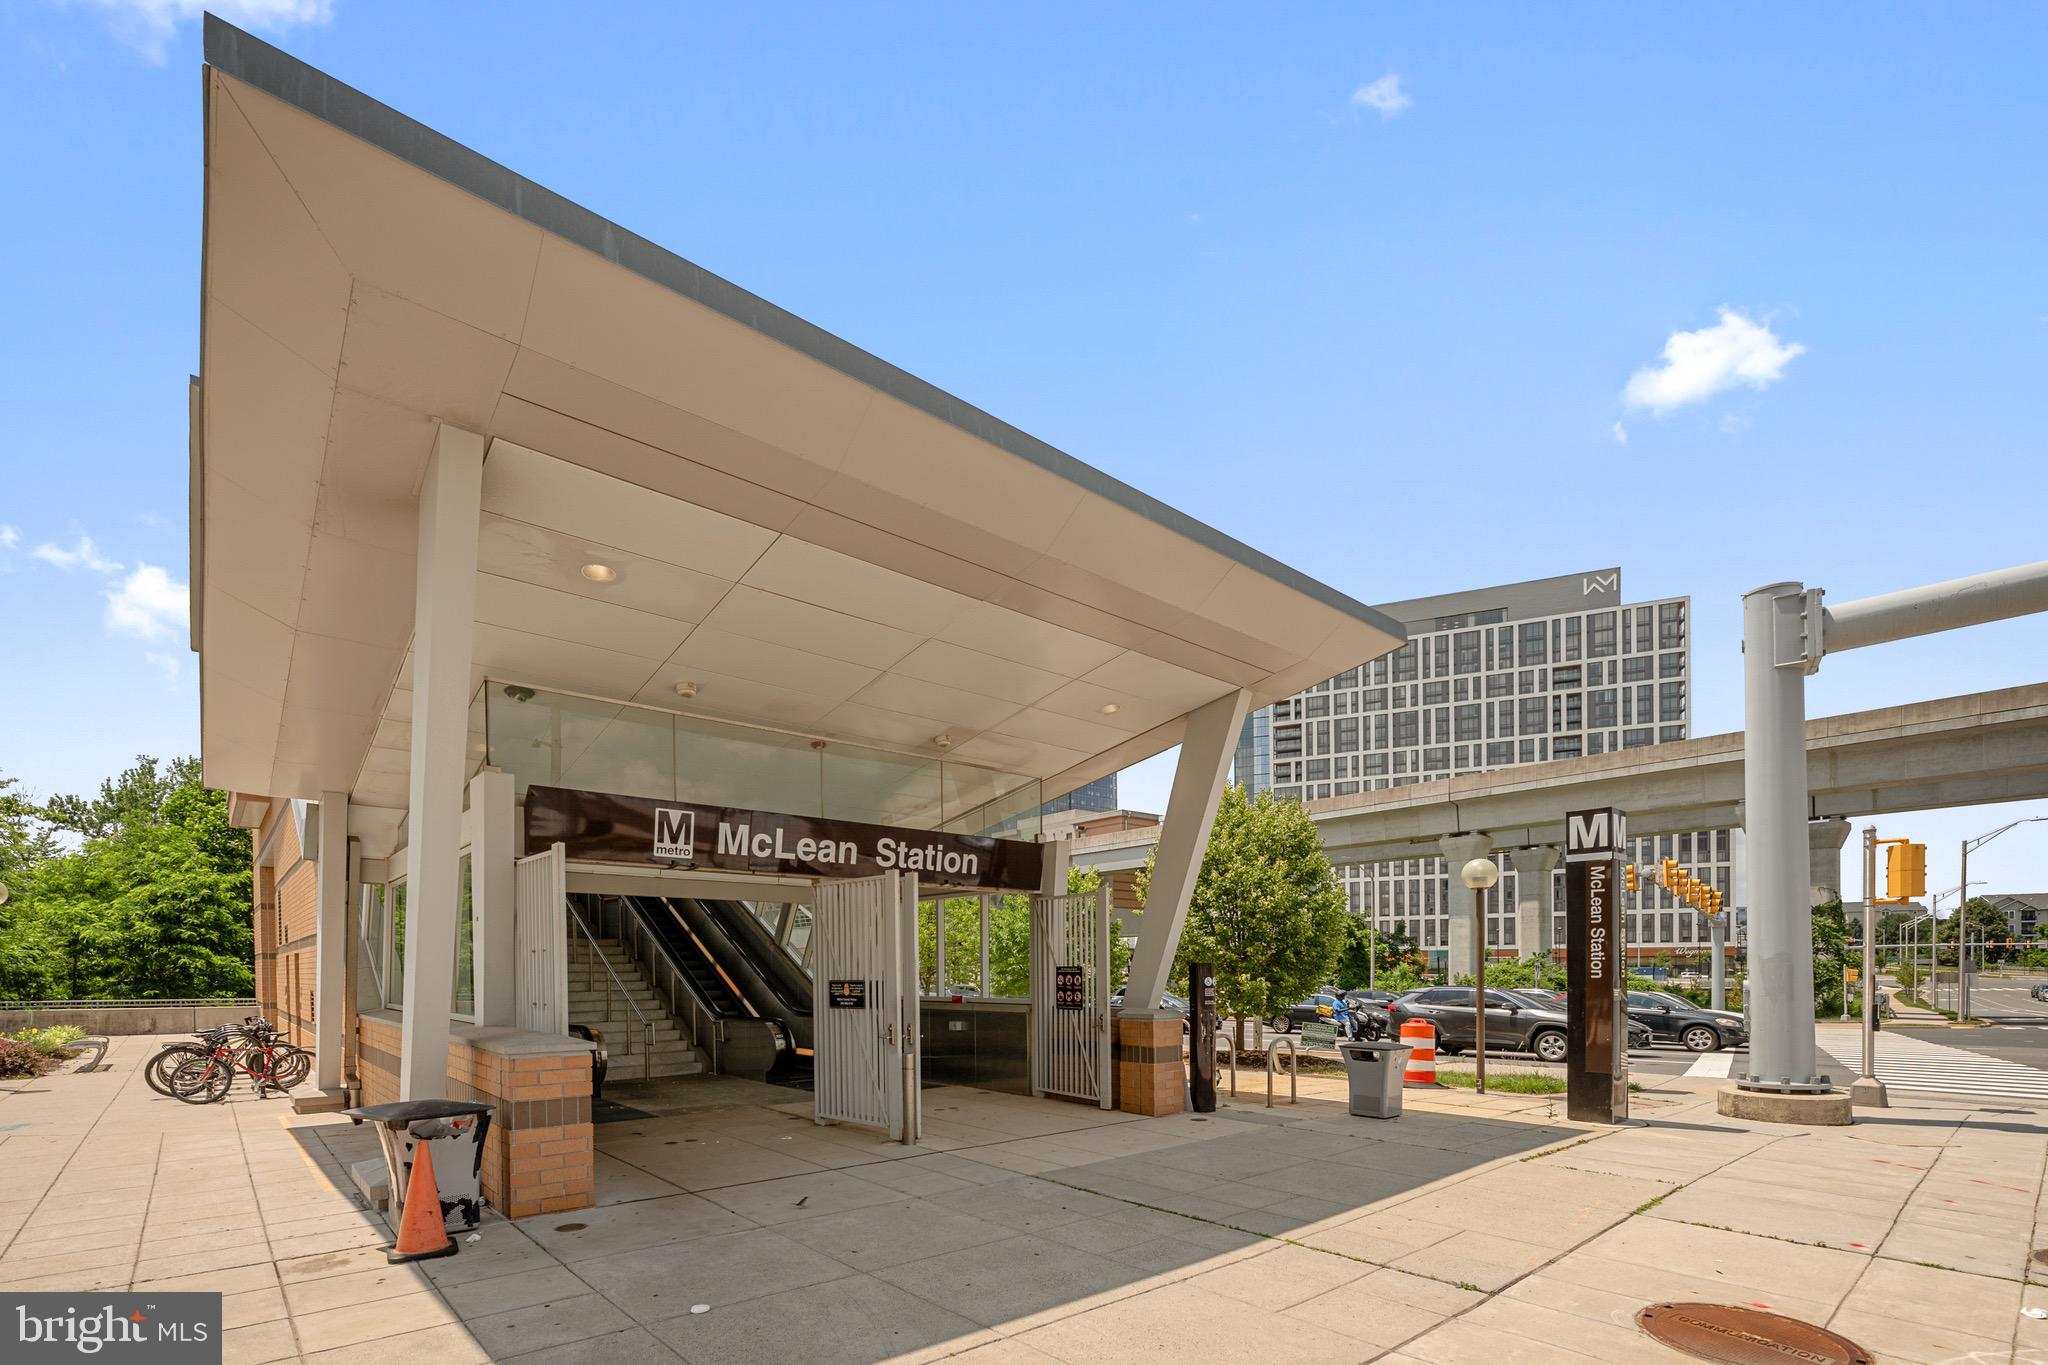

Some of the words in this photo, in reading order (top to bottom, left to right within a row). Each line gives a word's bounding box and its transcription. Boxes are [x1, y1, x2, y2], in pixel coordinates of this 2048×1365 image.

[656, 810, 692, 846] M
[1569, 813, 1608, 850] M
[1613, 813, 1627, 850] M
[656, 845, 691, 857] metro
[717, 822, 858, 865] McLean
[875, 837, 978, 875] Station
[1590, 866, 1606, 924] McLean
[1590, 927, 1606, 979] Station
